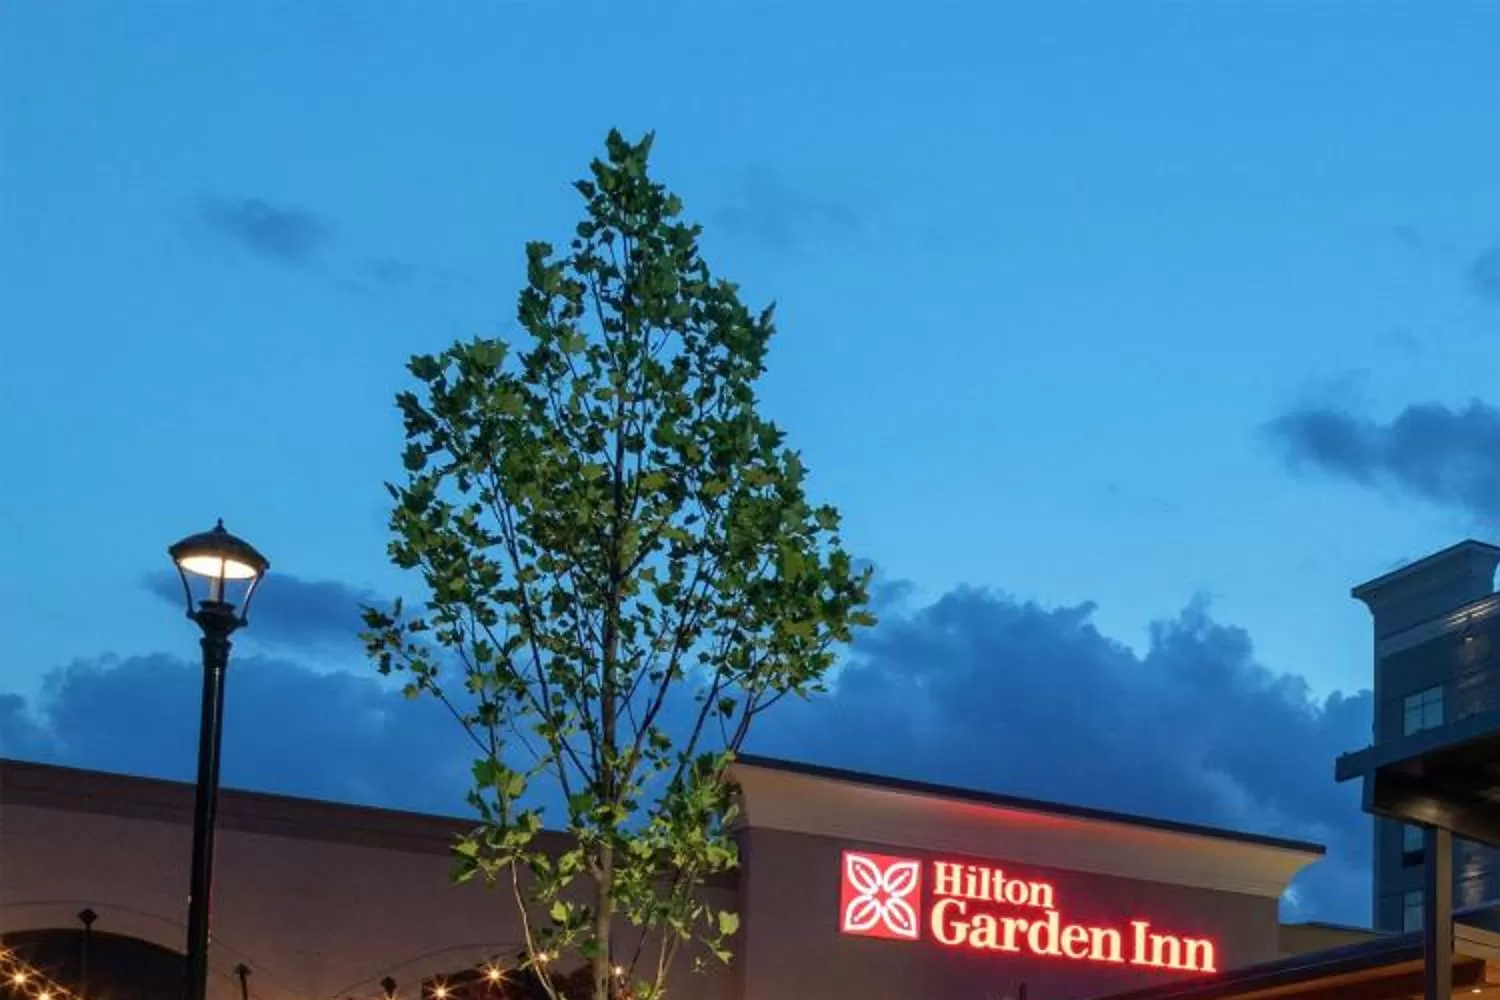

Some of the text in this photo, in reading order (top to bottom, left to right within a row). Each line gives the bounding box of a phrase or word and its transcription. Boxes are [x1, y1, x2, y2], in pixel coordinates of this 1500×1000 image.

[933, 860, 1054, 909] Hilton
[930, 897, 1217, 974] Garden Inn
